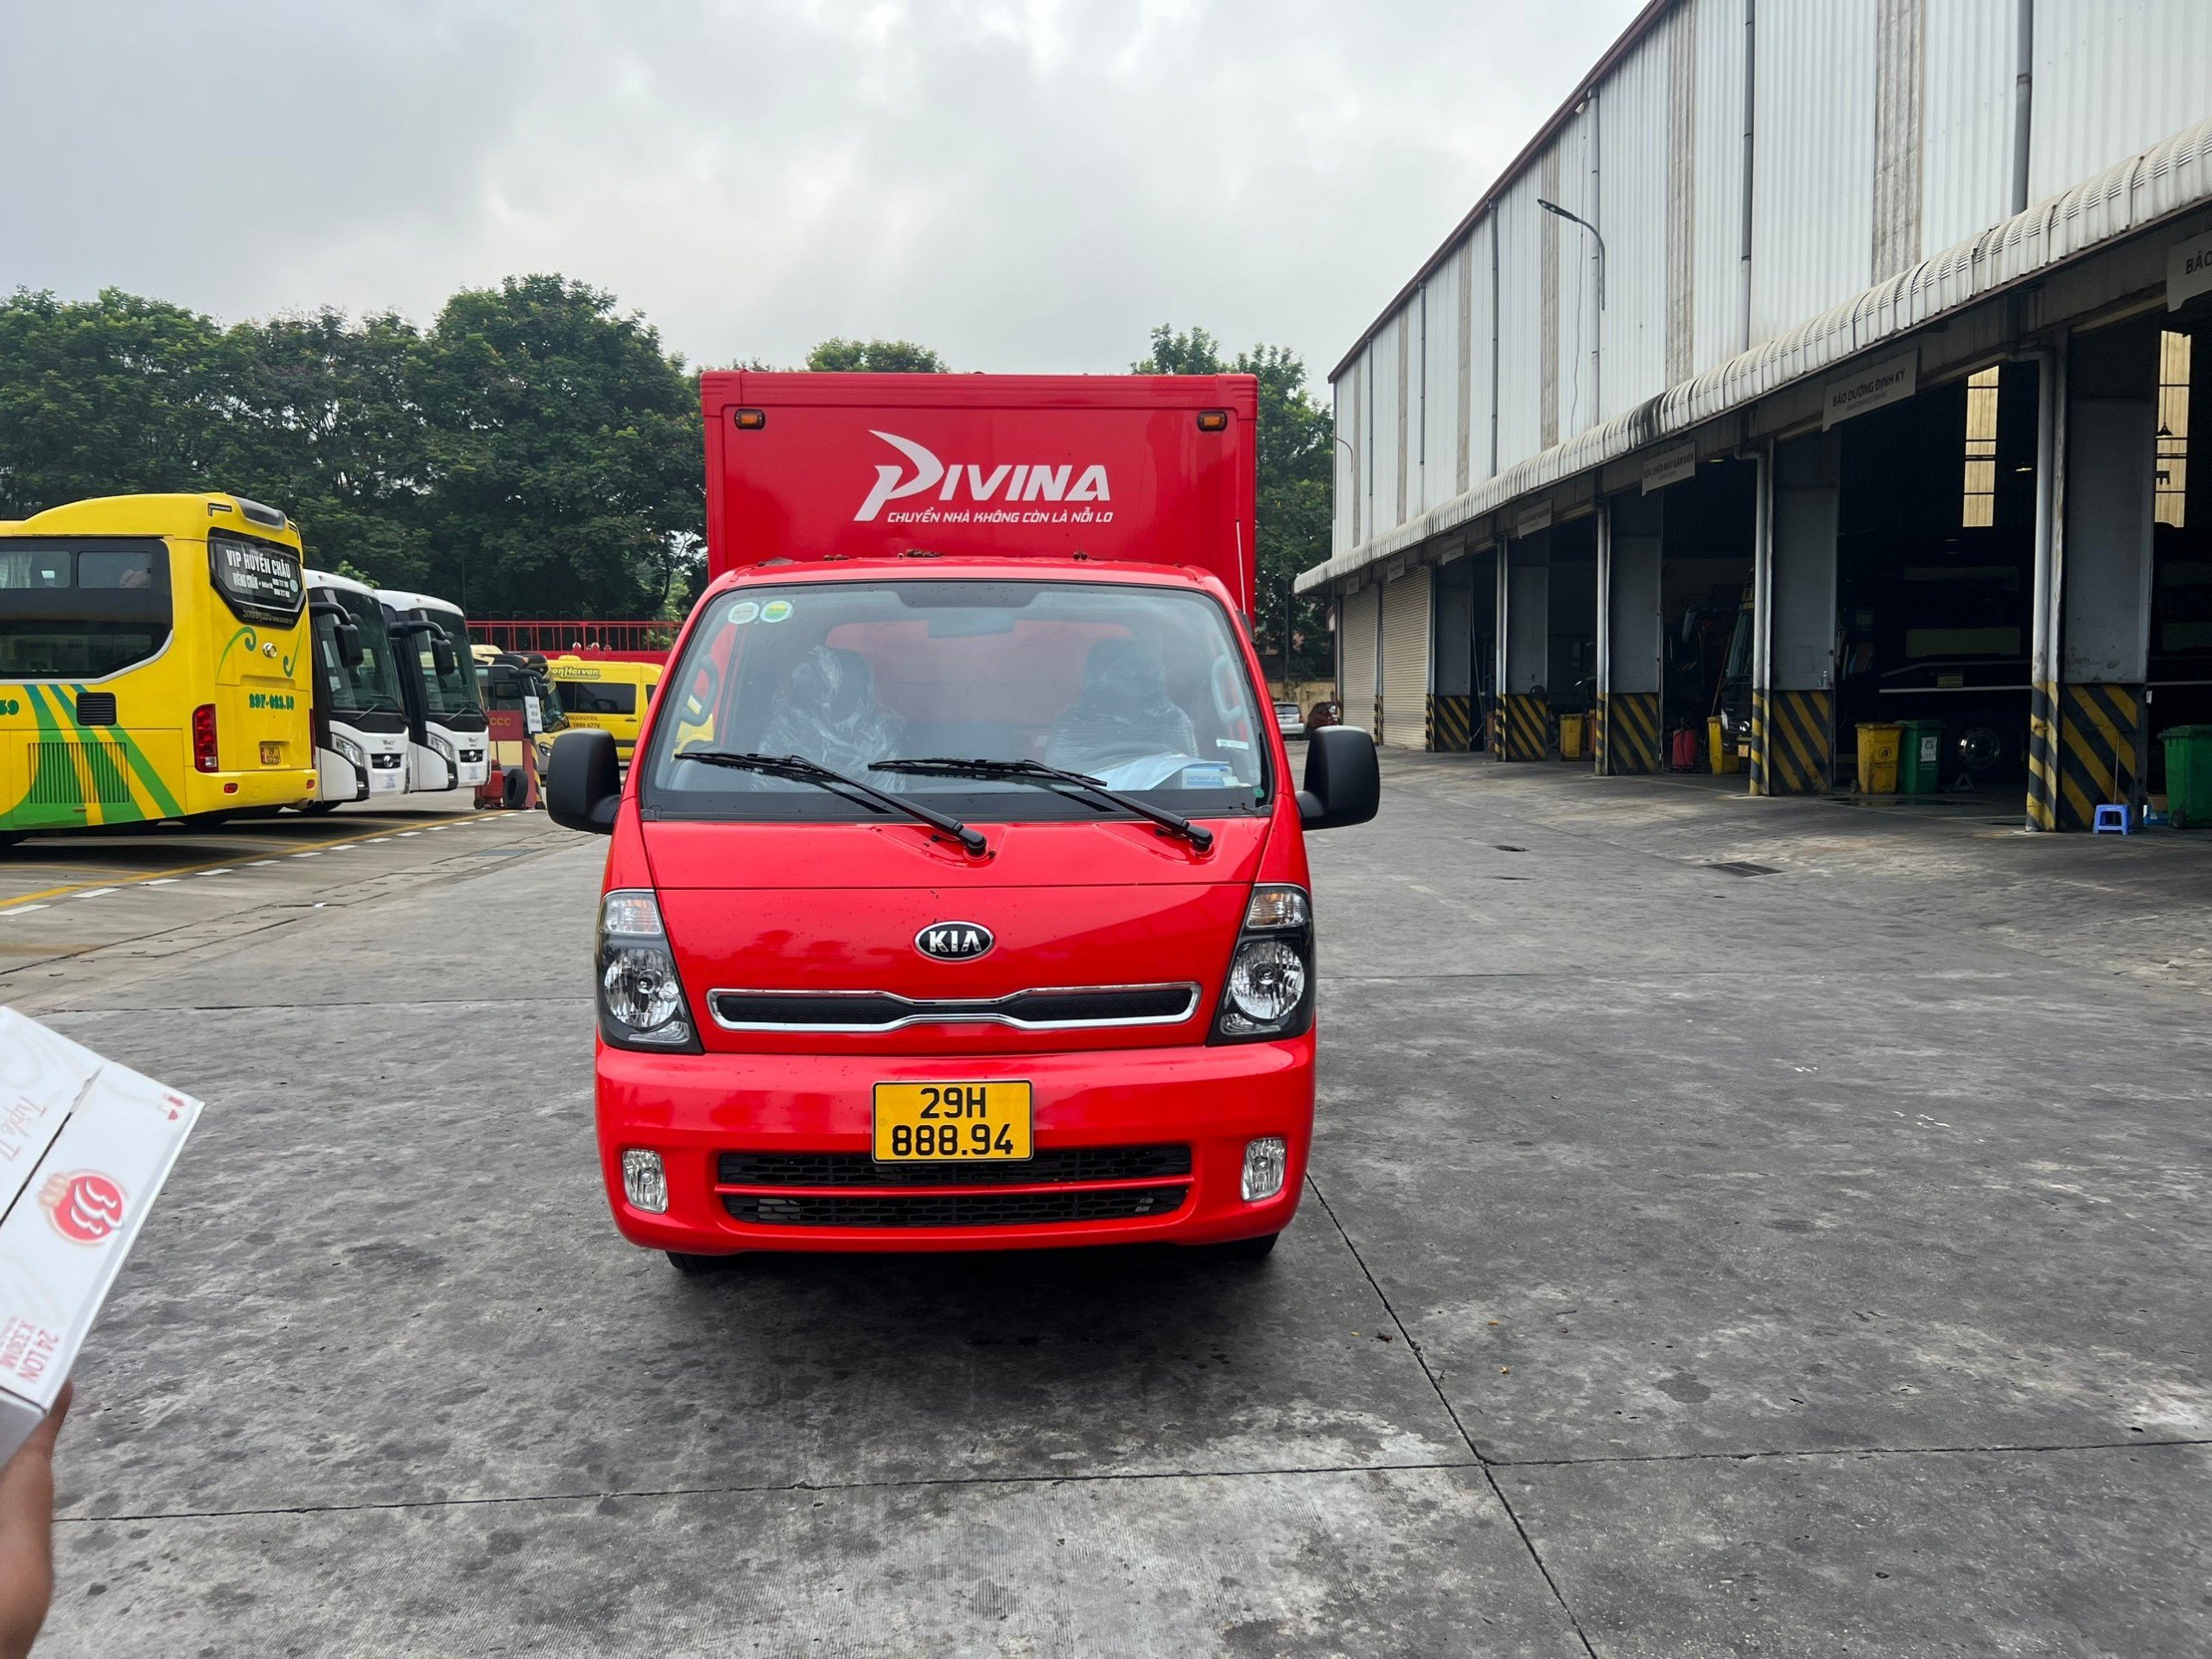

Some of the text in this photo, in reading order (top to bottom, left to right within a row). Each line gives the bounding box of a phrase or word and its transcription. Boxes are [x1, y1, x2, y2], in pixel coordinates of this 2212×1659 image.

[854, 429, 1110, 522] PIVINA
[887, 507, 1113, 523] CHUYỂN NHÀ KHÔNG CÒN LÀ NỖI LO
[226, 550, 241, 568] VIP
[271, 558, 291, 578] CHÂU
[929, 931, 982, 952] KIA
[920, 1087, 986, 1118] 29H
[892, 1123, 1014, 1156] 888.94
